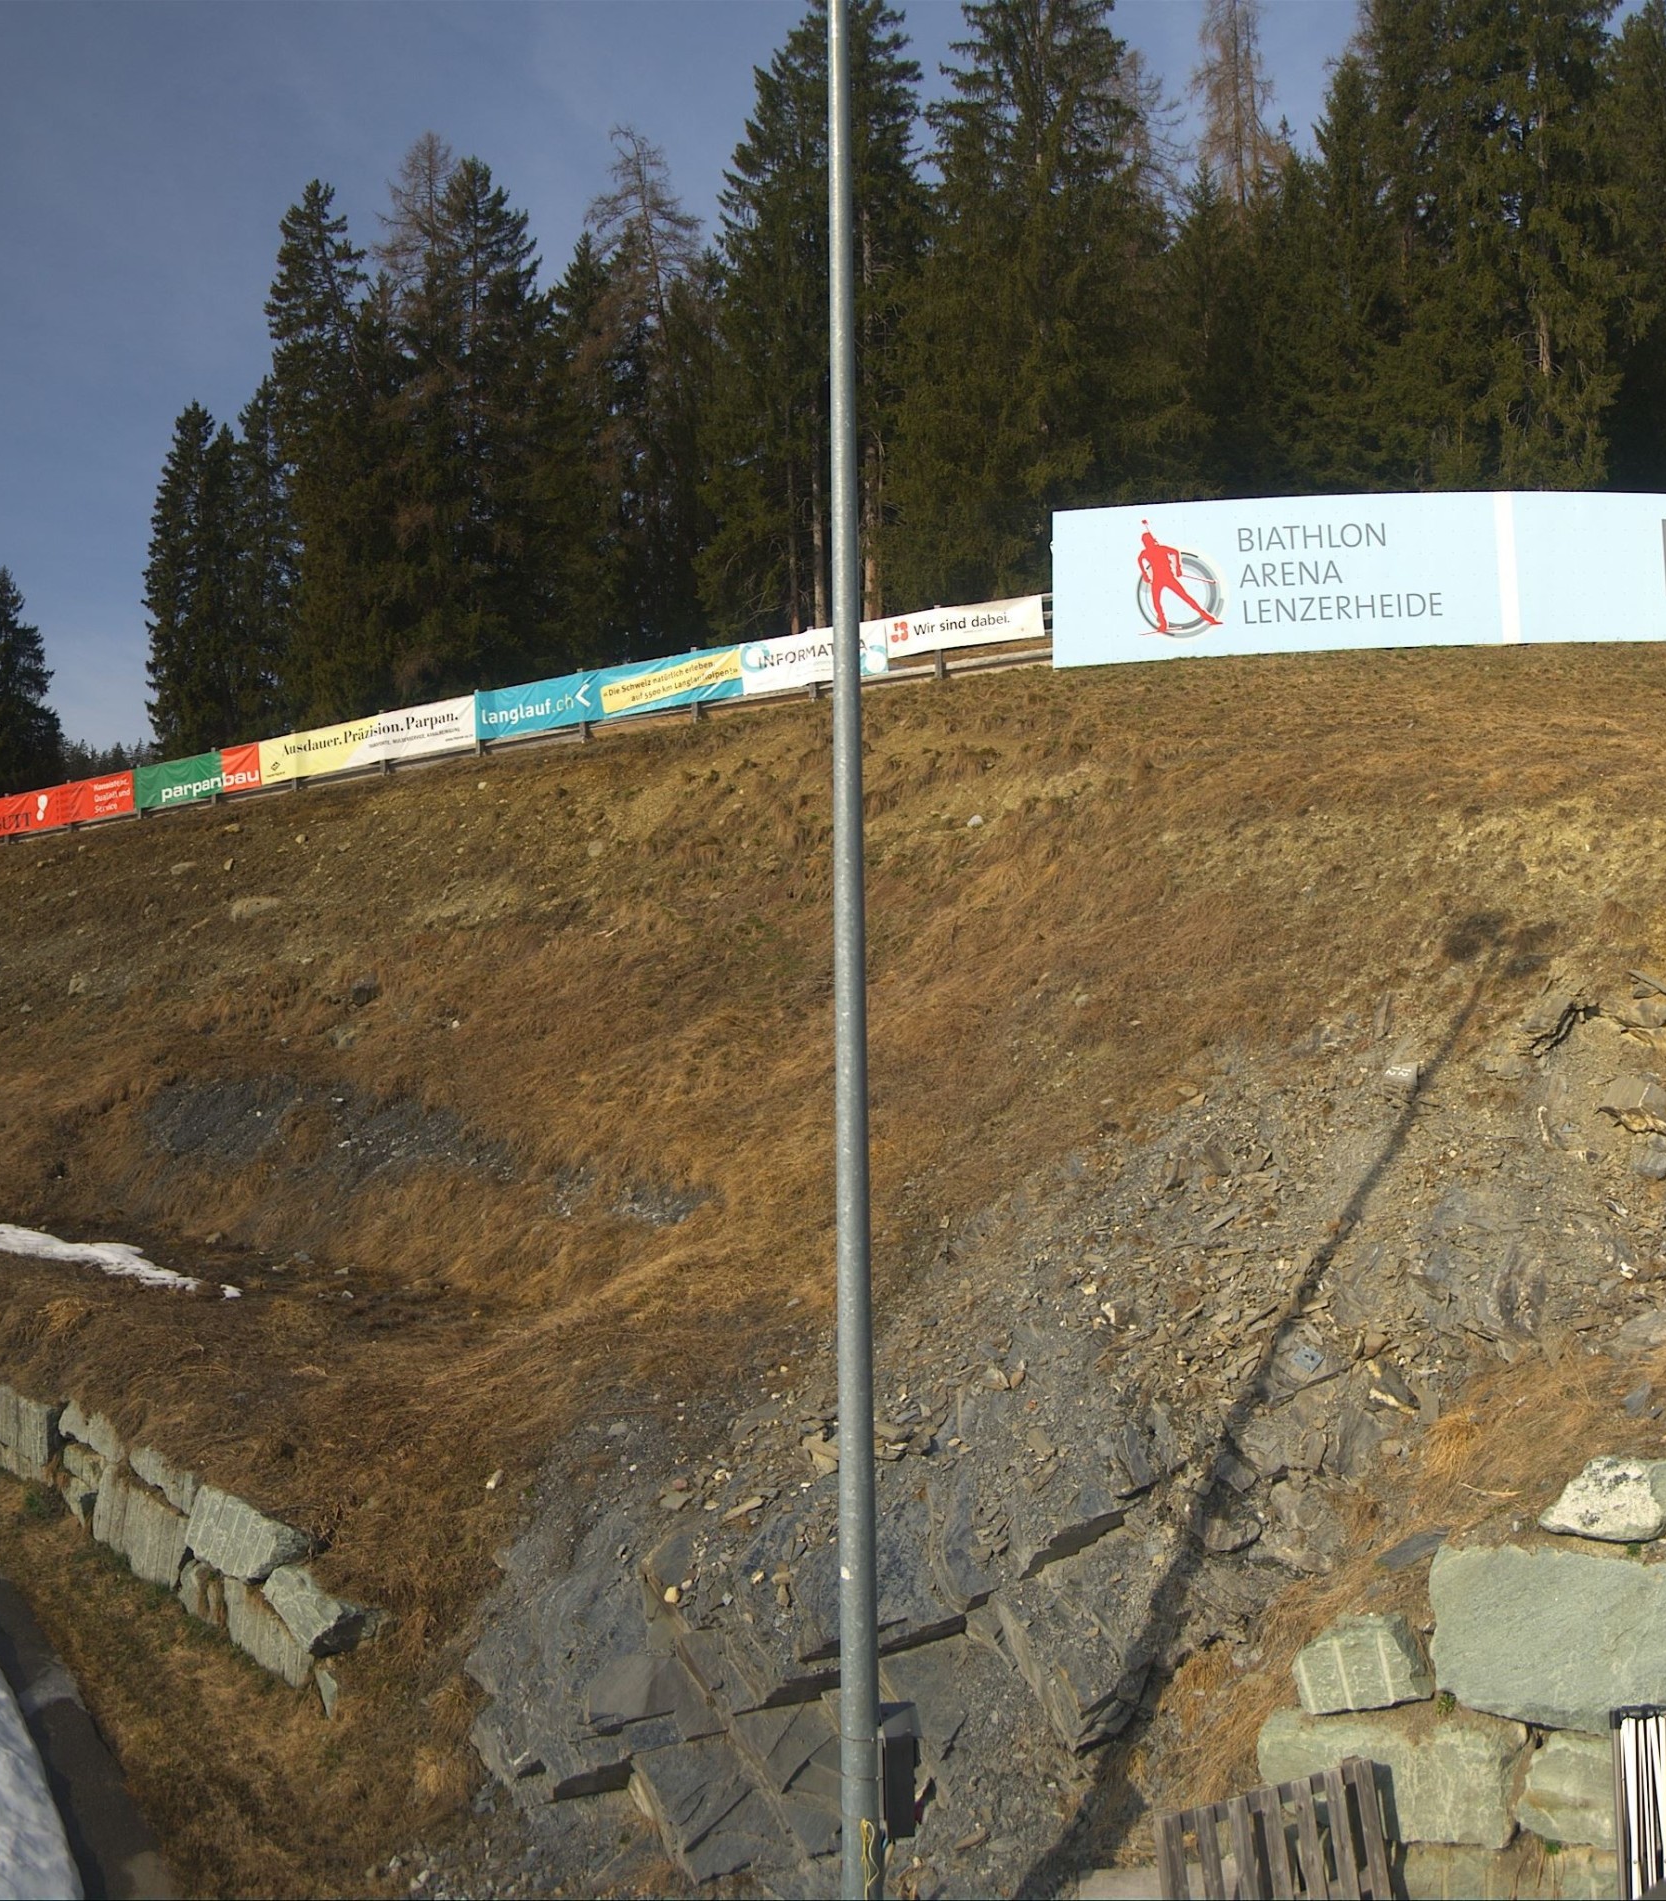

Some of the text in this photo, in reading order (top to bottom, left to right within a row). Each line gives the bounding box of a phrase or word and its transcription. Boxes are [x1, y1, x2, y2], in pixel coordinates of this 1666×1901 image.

[1237, 522, 1387, 552] BIATHLON
[1239, 560, 1343, 589] ARENA
[1243, 592, 1443, 624] LENZERHEIDE
[913, 611, 1011, 637] Wir sind dabei.
[758, 637, 868, 669] INFORMATA
[621, 680, 652, 693] Schweiz
[631, 692, 644, 702] auf
[644, 689, 662, 700] 5500
[662, 685, 673, 694] km
[482, 693, 574, 725] langlauf.ch
[283, 711, 459, 756] Ausdauer. Präzision. Parpan.
[161, 769, 260, 803] parpanbau
